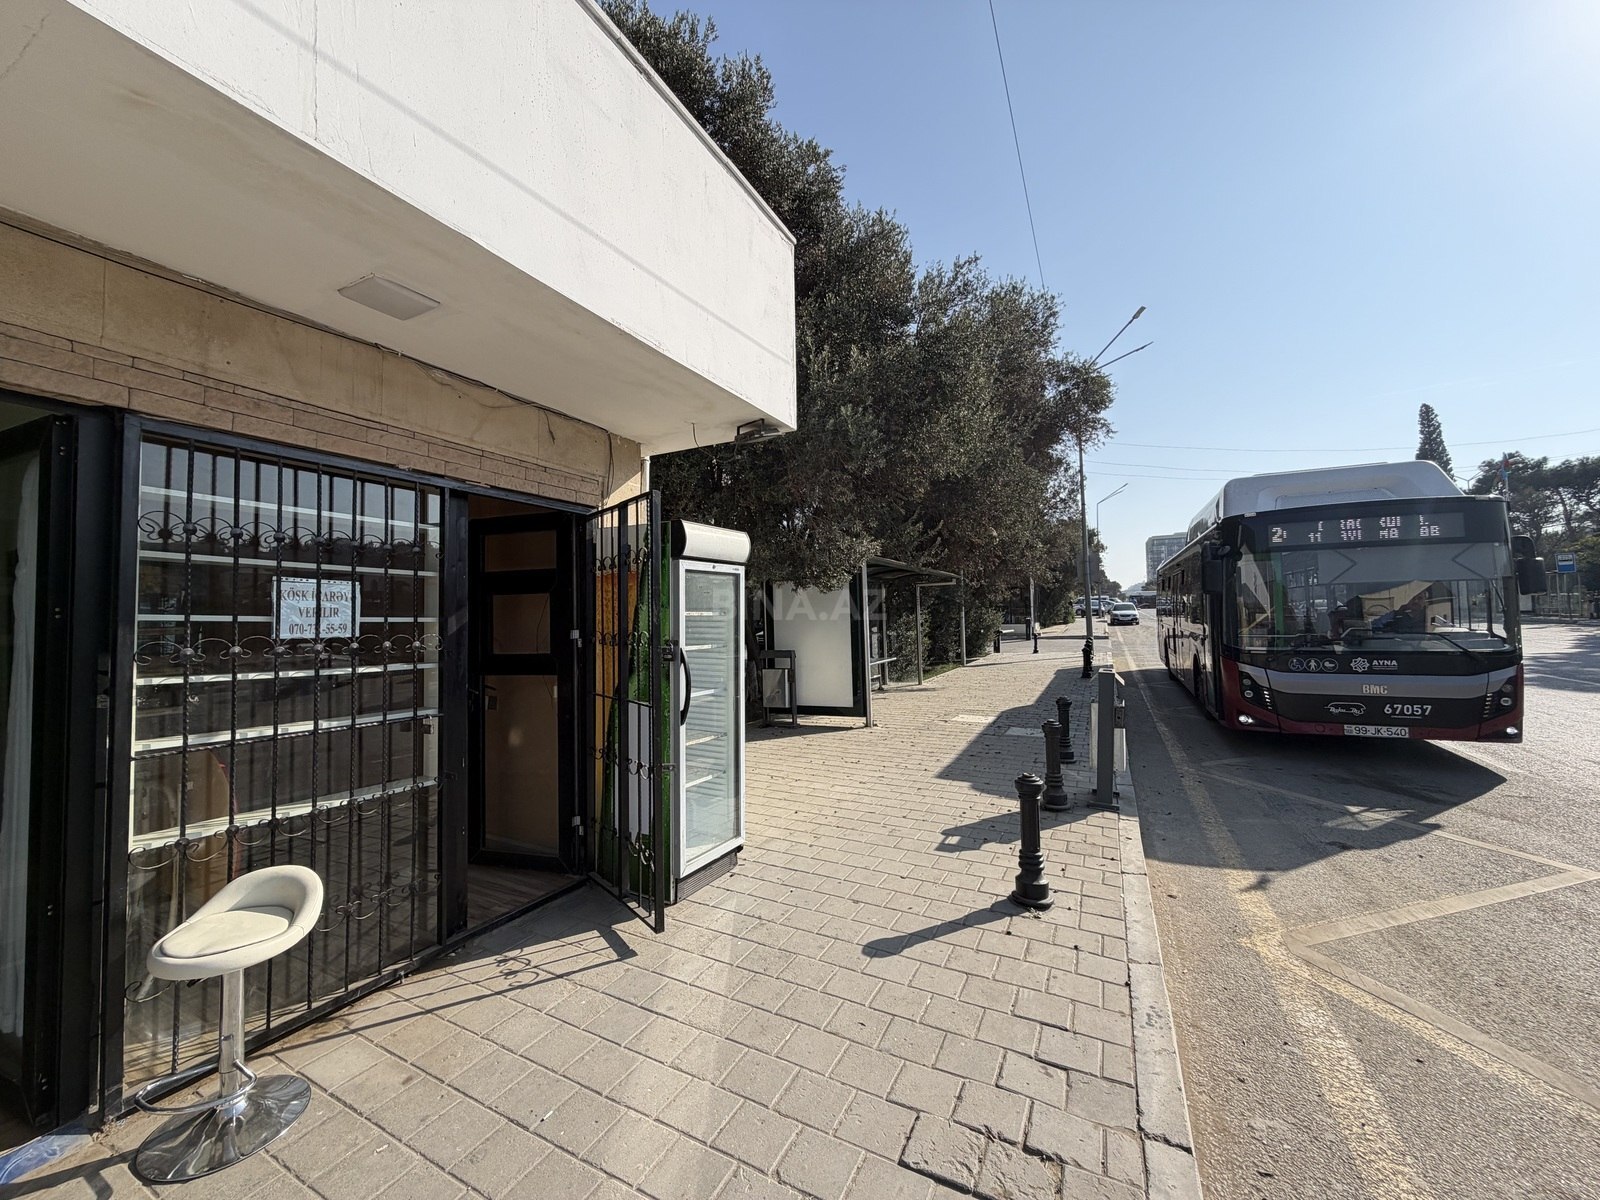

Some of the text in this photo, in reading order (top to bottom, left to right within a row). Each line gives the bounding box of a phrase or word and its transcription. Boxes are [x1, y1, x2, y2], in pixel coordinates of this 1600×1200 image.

[281, 587, 356, 604] KÖŞK İARƏY
[298, 605, 341, 618] VELİR
[289, 623, 348, 635] 070-7-55-59
[1362, 684, 1388, 695] BMC
[1384, 704, 1432, 716] 67057
